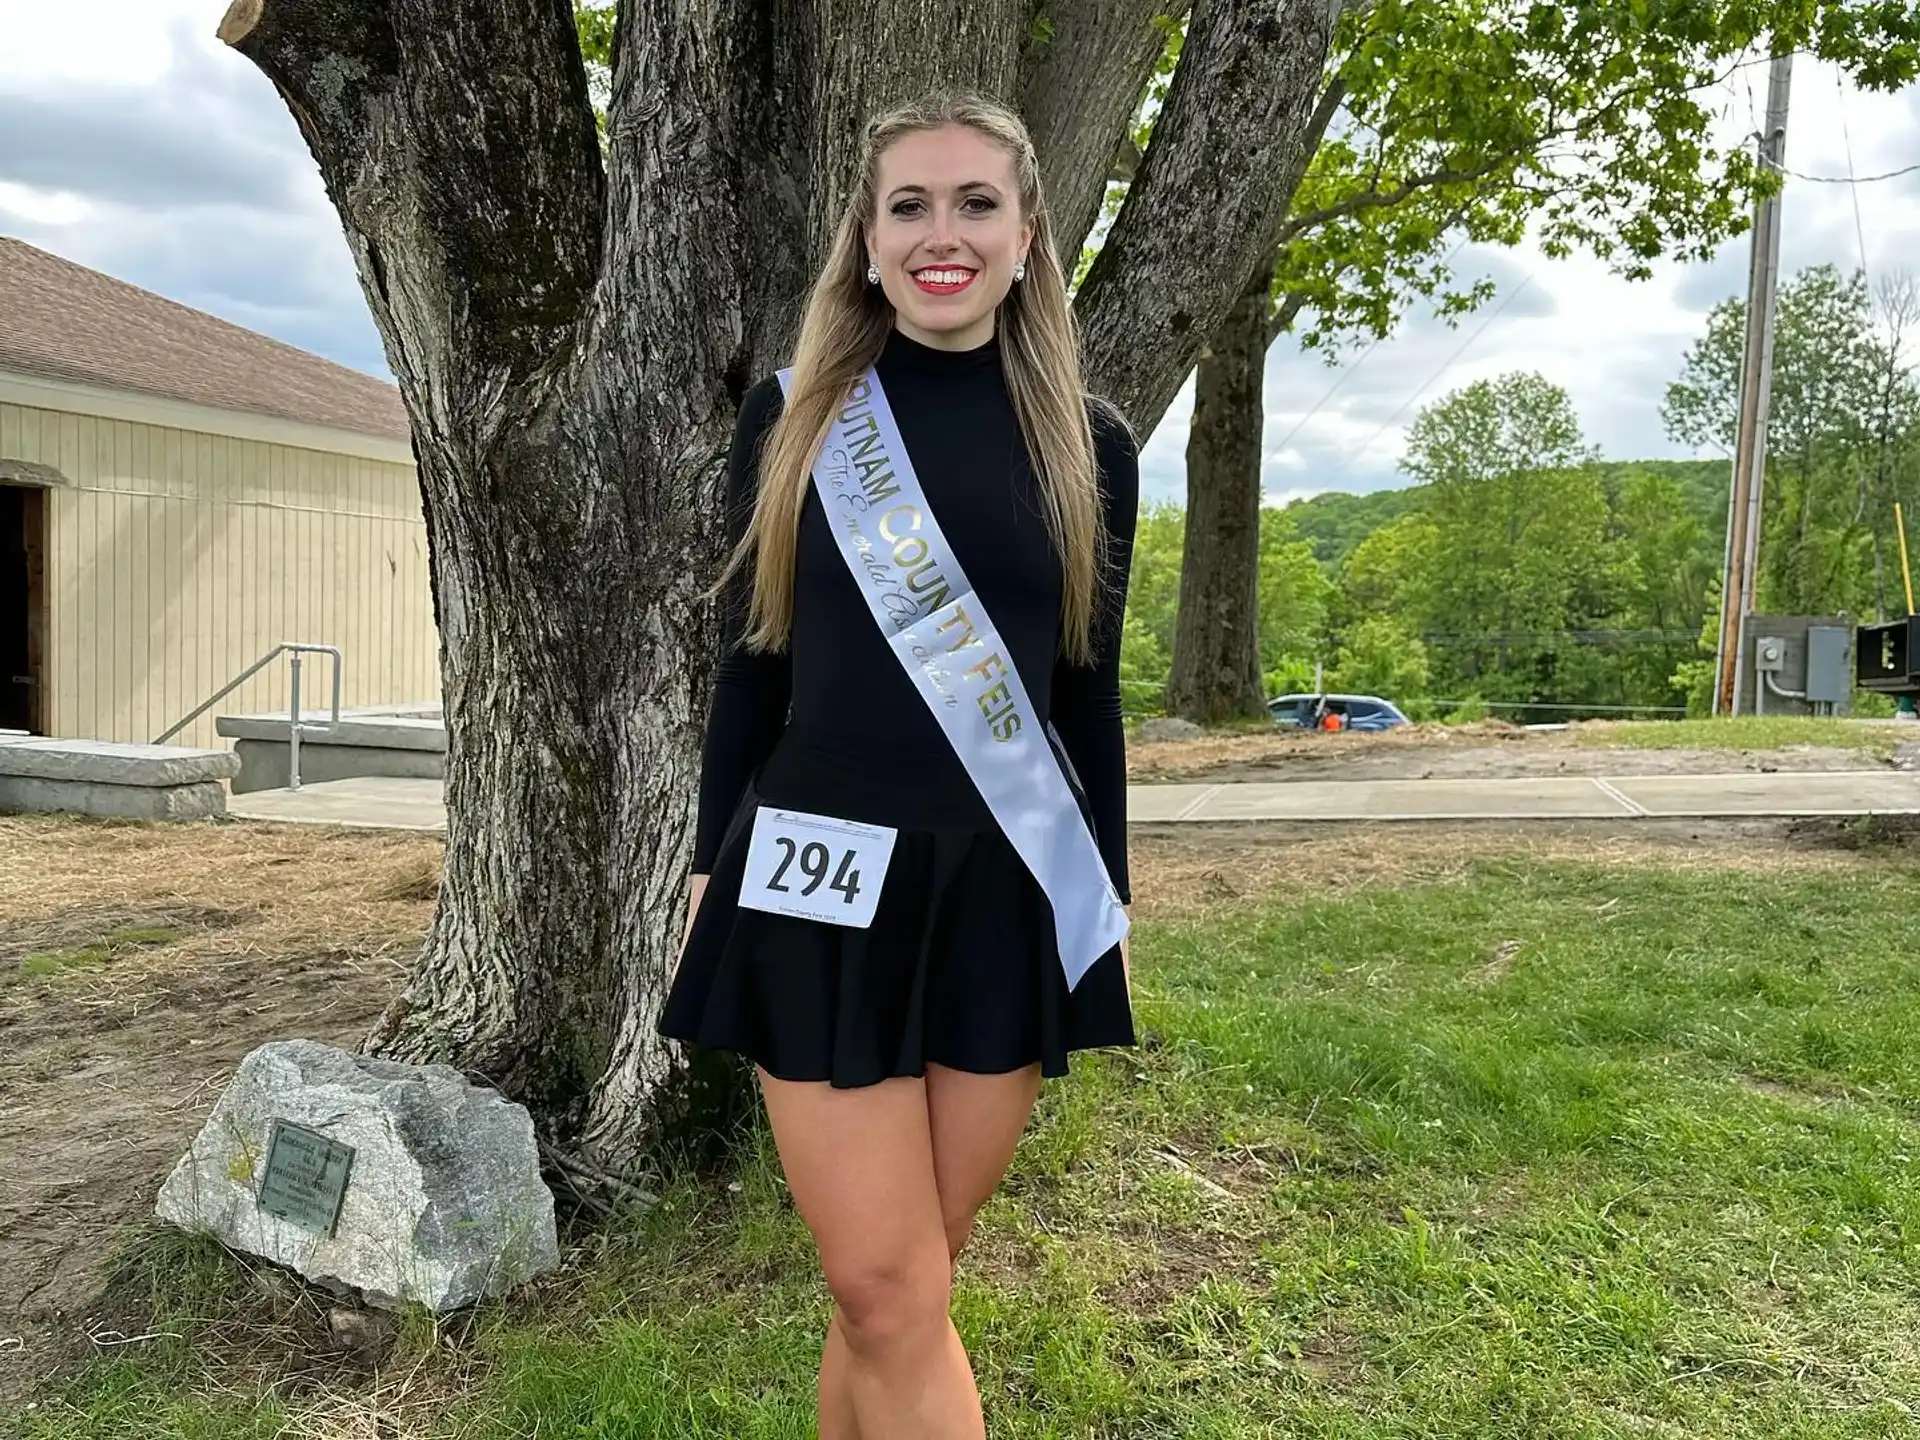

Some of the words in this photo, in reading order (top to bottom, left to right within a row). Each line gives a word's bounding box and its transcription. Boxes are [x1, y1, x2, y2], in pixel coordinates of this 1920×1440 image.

[822, 445, 850, 490] The
[834, 492, 897, 588] Emerald
[878, 504, 984, 656] COUNTY
[962, 652, 1022, 742] FEIS
[766, 837, 861, 904] 294
